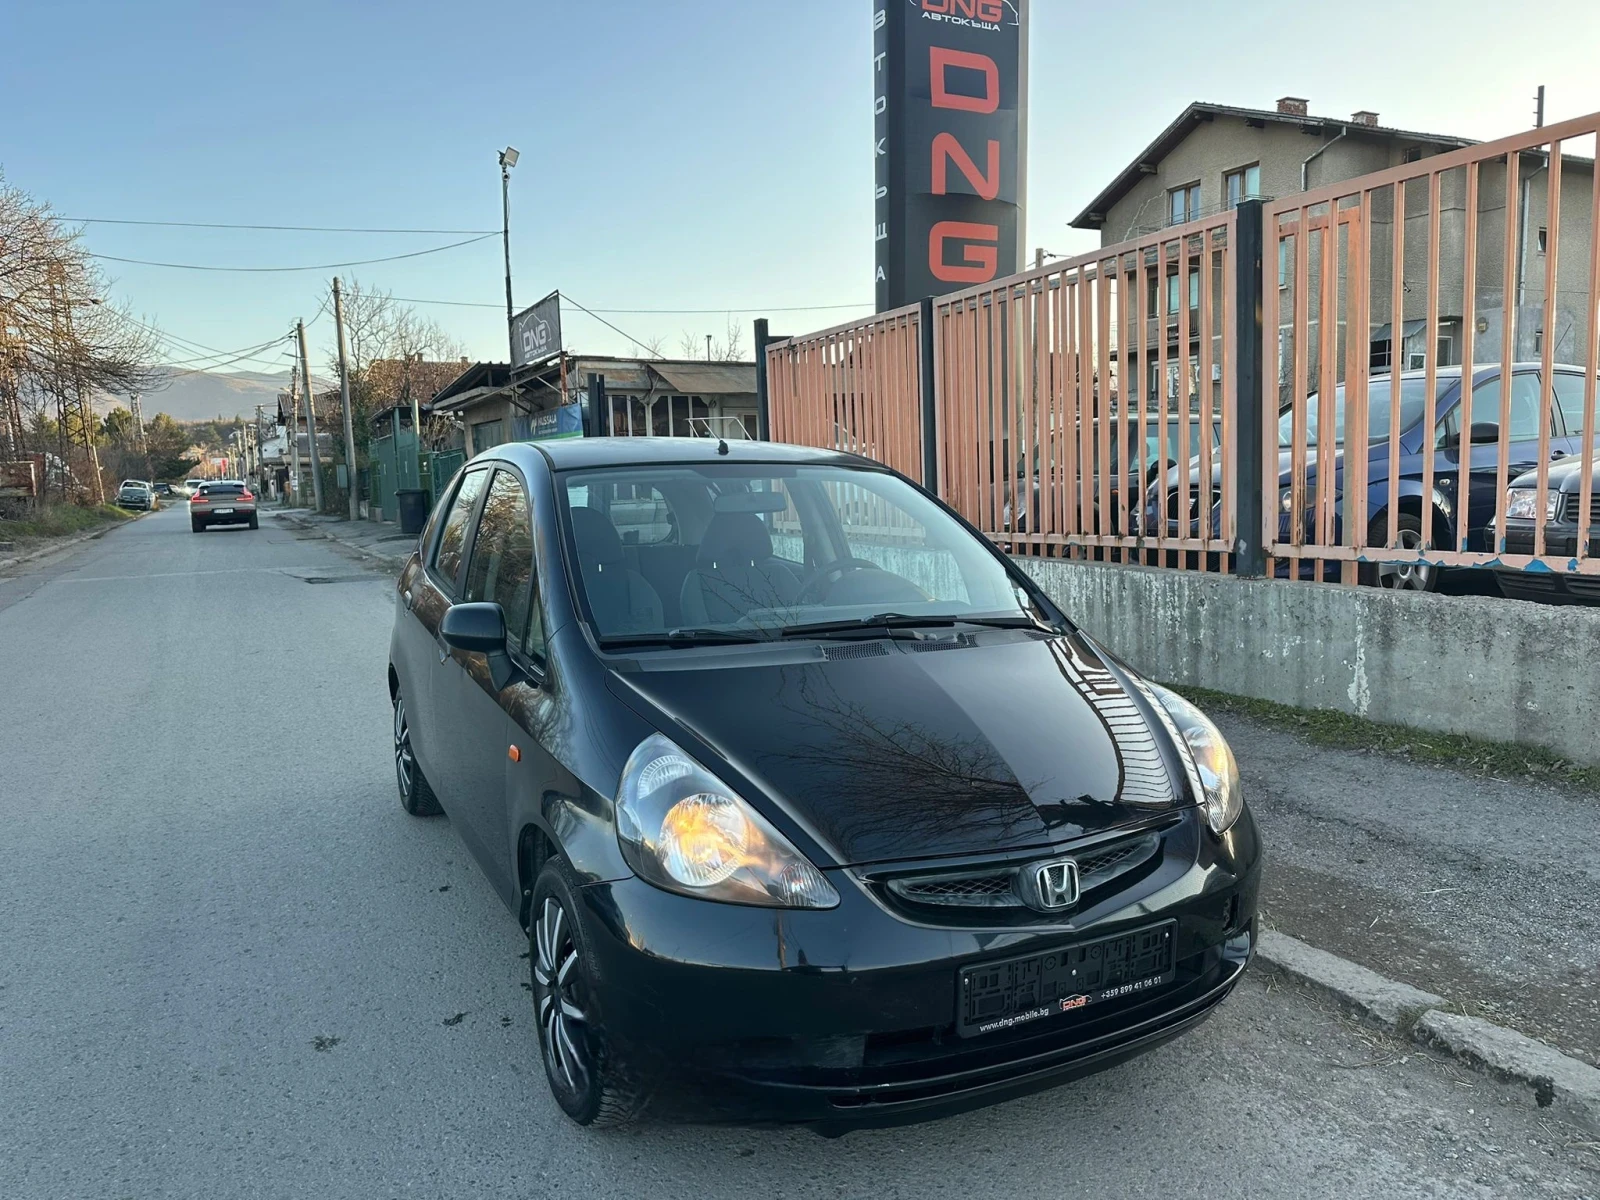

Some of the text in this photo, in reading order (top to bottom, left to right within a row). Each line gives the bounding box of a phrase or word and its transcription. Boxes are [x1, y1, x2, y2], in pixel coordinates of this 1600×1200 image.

[523, 322, 547, 352] DNG
[1101, 988, 1119, 999] +359
[1120, 984, 1133, 994] 899
[1134, 981, 1142, 990] 41
[1154, 976, 1162, 984] 01
[979, 1007, 1049, 1032] www.dng.mobile.bg
